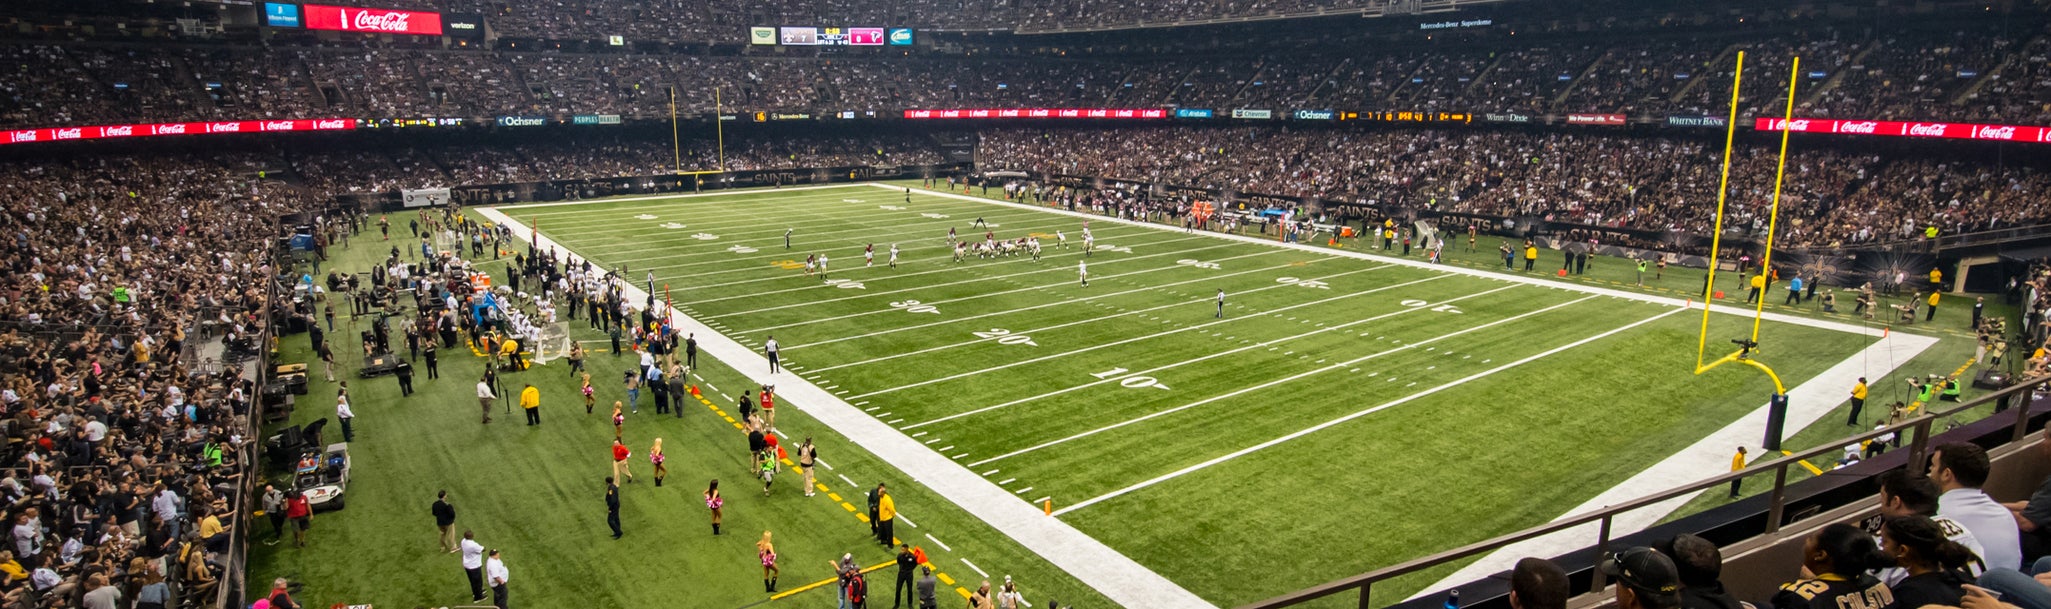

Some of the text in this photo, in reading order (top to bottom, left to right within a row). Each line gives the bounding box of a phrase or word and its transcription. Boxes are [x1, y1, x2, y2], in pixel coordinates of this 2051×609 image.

[355, 10, 409, 31] Coca-Cola
[1420, 19, 1492, 29] Mercedes-Benz Superdome
[1300, 110, 1331, 119] Ochsner
[1486, 113, 1528, 122] Winn Dixie
[319, 119, 345, 129] Coca-Cola
[505, 116, 543, 126] Ochsner
[574, 116, 598, 124] PEOPLES
[1669, 116, 1724, 126] WHITNEY BANK
[159, 124, 185, 134] Coca-Cola
[212, 122, 240, 132] Coca-Cola
[267, 121, 293, 130] Coca-Cola
[1841, 121, 1877, 133] Coca-Cola
[1910, 123, 1947, 136] Coca-Cola
[107, 126, 132, 137] Coca-Cola
[1979, 125, 2016, 139] Coca-Cola
[1441, 215, 1491, 231] SAINTS
[889, 300, 936, 313] 30
[972, 328, 1030, 345] 20
[1089, 366, 1157, 388] 10
[1866, 515, 1881, 533] 249
